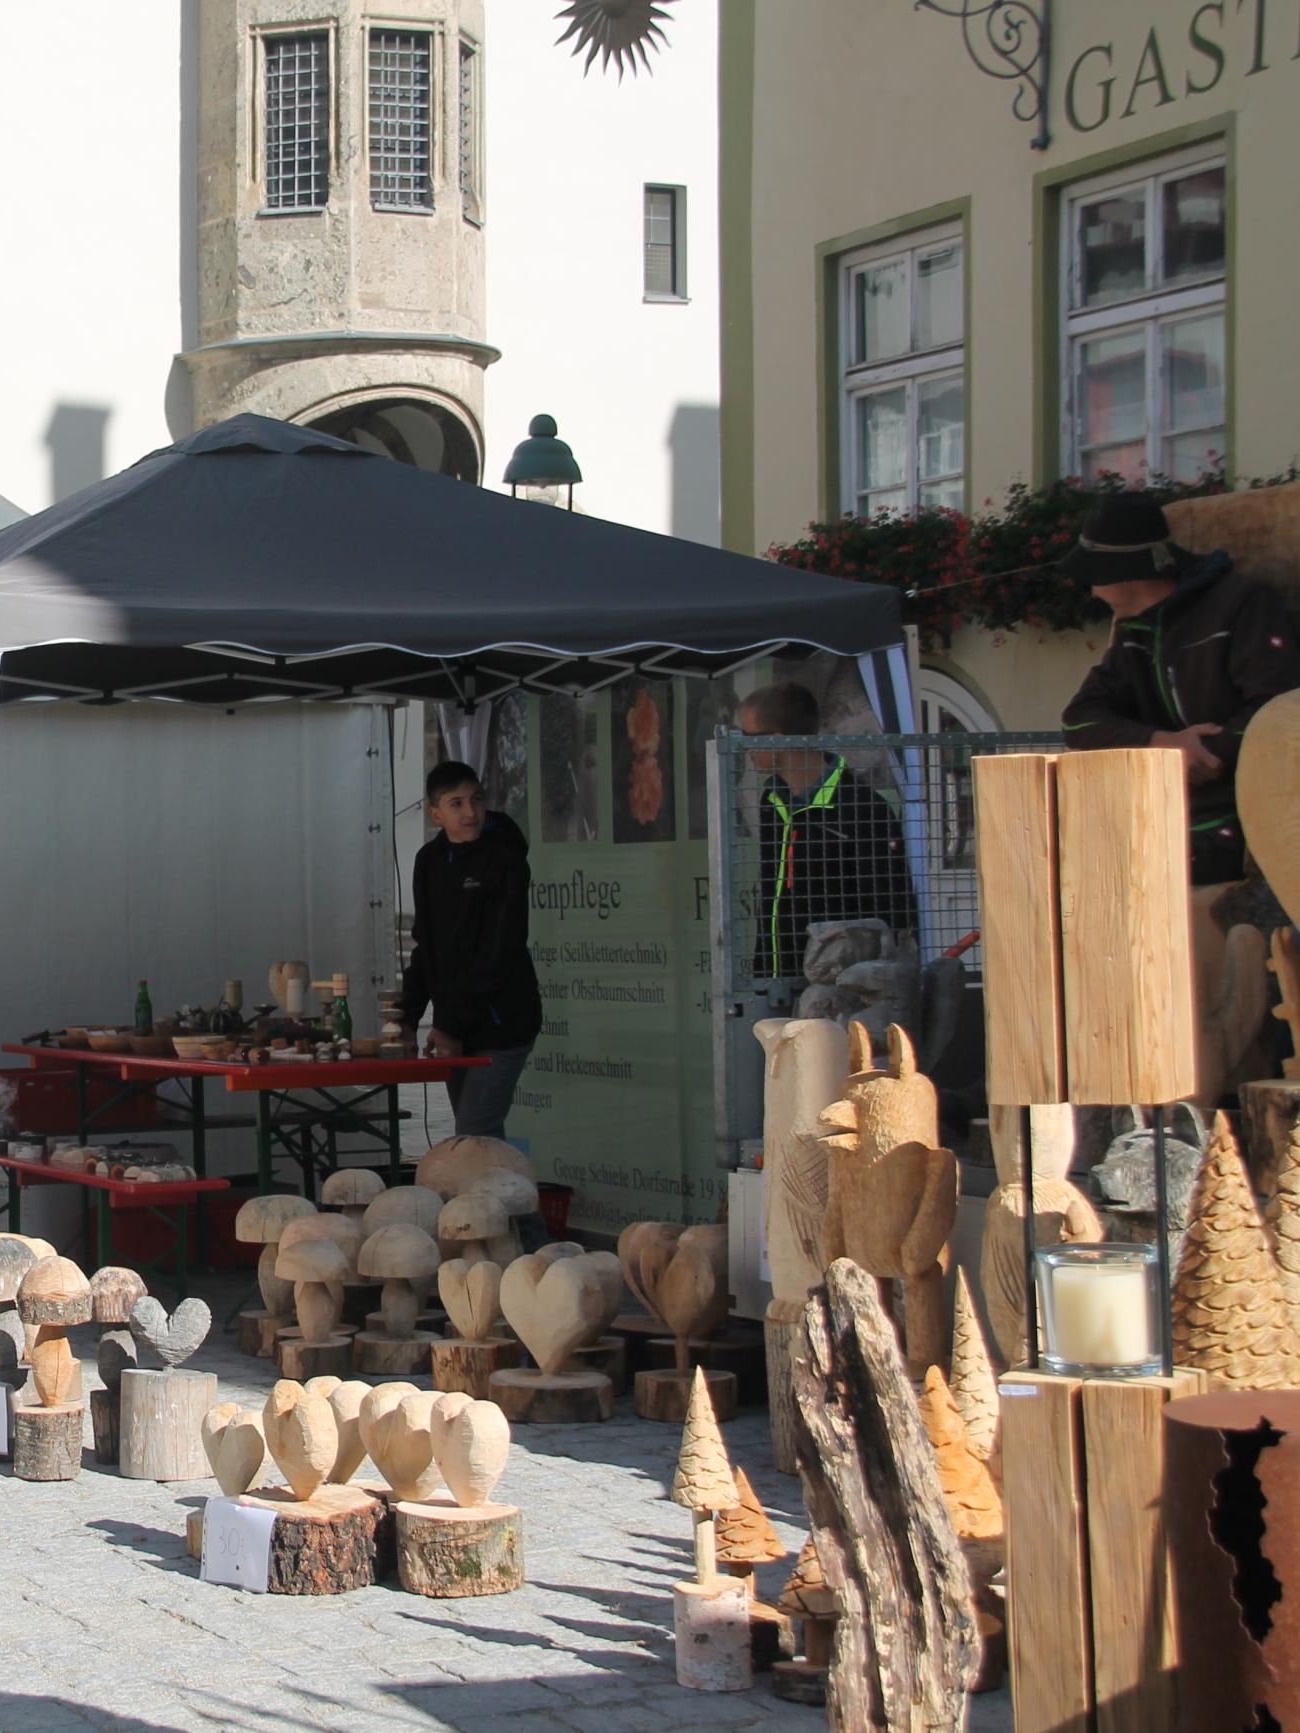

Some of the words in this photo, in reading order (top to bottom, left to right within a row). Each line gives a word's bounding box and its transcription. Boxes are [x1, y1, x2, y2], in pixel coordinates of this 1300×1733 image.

[1063, 0, 1300, 134] GAST
[530, 870, 622, 921] tenpflege
[531, 941, 557, 967] flege
[560, 940, 668, 968] (Seilklettertechnik)
[539, 978, 569, 1000] echter
[571, 978, 666, 1004] Obstbaumschnitt
[541, 1016, 569, 1036] chnitt
[535, 1051, 553, 1073] und
[555, 1052, 633, 1080] Heckenschnitt
[513, 1086, 552, 1112] llungen
[552, 1157, 587, 1187] Georg
[589, 1161, 629, 1189] Schiele
[633, 1168, 695, 1197] Dorfstraße
[699, 1177, 714, 1201] 19
